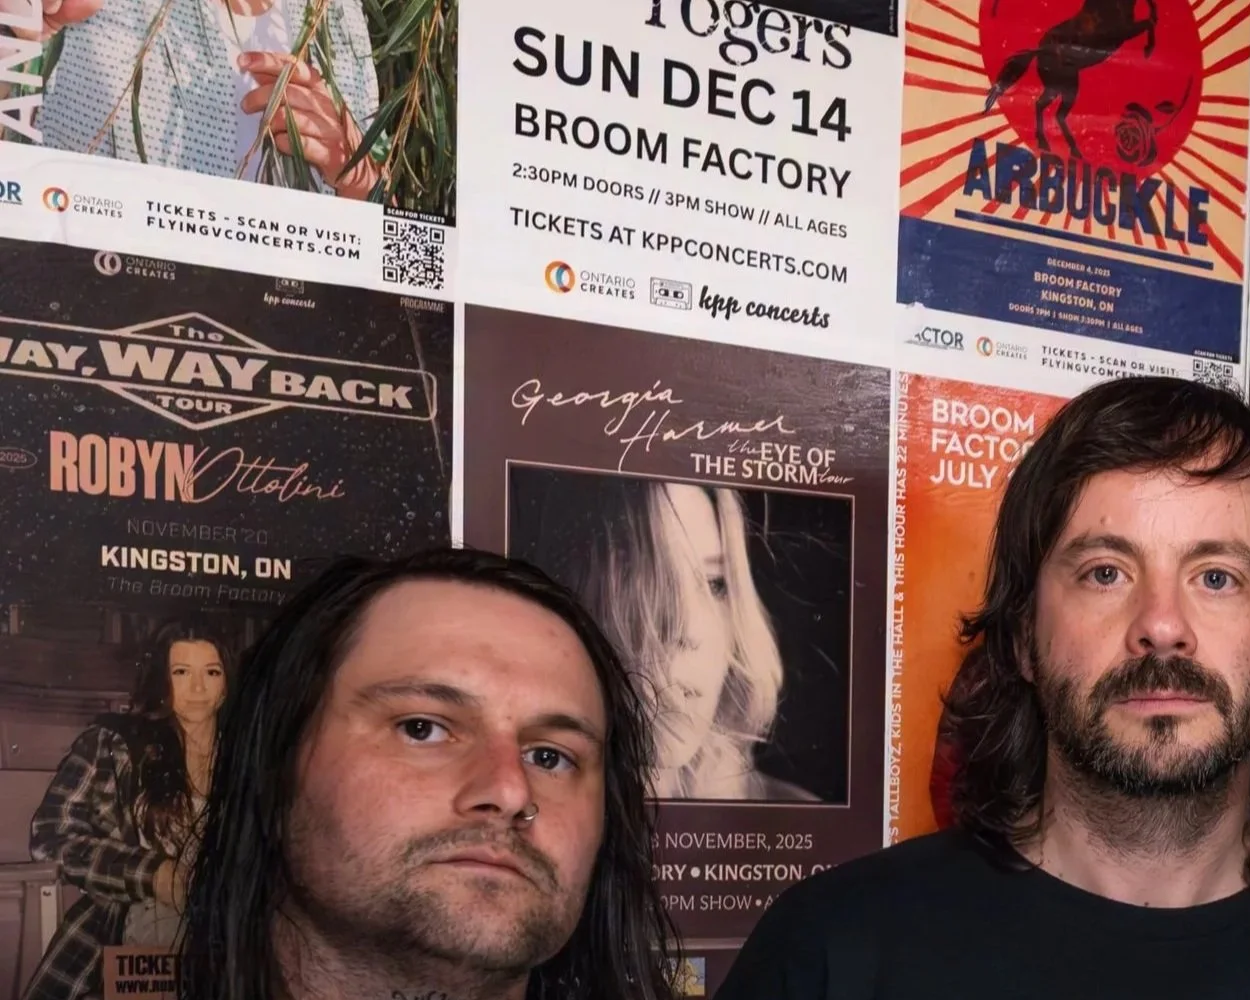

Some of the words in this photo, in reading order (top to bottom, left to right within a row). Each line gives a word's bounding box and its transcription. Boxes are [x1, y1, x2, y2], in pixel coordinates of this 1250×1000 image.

[512, 25, 641, 99] SUN
[662, 58, 776, 126] DEC
[791, 89, 852, 143] 14
[514, 102, 668, 165] BROOM
[682, 137, 852, 199] FACTORY
[73, 194, 123, 209] ONTARIO
[512, 162, 578, 190] 2:30PM
[583, 175, 645, 200] DOORS
[665, 191, 700, 211] 3PM
[704, 199, 755, 222] SHOW
[773, 212, 803, 231] ALL
[806, 218, 848, 239] AGES
[963, 138, 1210, 246] ARBUCKLE
[74, 204, 123, 218] CREATES
[146, 200, 216, 222] TICKETS
[237, 216, 280, 232] SCAN
[286, 225, 307, 236] OR
[316, 228, 361, 246] VISIT:
[386, 208, 404, 217] SCAN
[405, 211, 418, 219] FOR
[419, 213, 445, 224] TICKETS
[146, 216, 361, 260] FLYINGVCONCERTS.COM
[509, 207, 603, 241] TICKETS
[608, 226, 636, 247] AT
[641, 232, 848, 284] KPPCONCERTS.COM
[125, 255, 177, 273] ONTARIO
[125, 265, 177, 281] CREATES
[1047, 257, 1085, 272] DECEMBER
[580, 269, 636, 289] ONTARIO
[580, 283, 635, 300] CREATES
[1034, 271, 1074, 289] BROOM
[1076, 280, 1122, 298] FACTORY
[263, 292, 280, 306] kpp
[281, 296, 316, 309] concerts
[399, 297, 445, 313] PROGRAMME
[699, 285, 742, 320] kpp
[745, 299, 831, 330] concerts
[1009, 302, 1034, 314] DOORS
[1041, 289, 1097, 311] KINGSTON,
[1099, 301, 1114, 313] ON
[168, 323, 224, 343] The
[996, 350, 1028, 361] CREATES
[1042, 346, 1086, 361] TICKETS
[1100, 356, 1126, 368] SCAN
[1131, 361, 1145, 371] OR
[1149, 364, 1180, 377] VISIT:
[99, 339, 271, 394] WAY
[270, 369, 412, 410] BACK
[157, 394, 233, 415] TOUR
[511, 379, 683, 436] Georgia
[897, 373, 911, 441] MINUTES
[932, 398, 1035, 435] BROOM
[618, 410, 796, 472] Harmer
[761, 441, 802, 465] EYE
[806, 447, 837, 468] OF
[896, 445, 907, 464] 22
[50, 430, 195, 503] ROBYN
[183, 446, 346, 503] Ottolini
[690, 453, 737, 477] THE
[746, 459, 818, 485] STORM
[929, 459, 999, 489] JULY
[896, 467, 907, 500] HAS
[127, 518, 237, 541] NOVEMBER
[894, 504, 906, 548] HOUR
[101, 545, 248, 580] KINGSTON,
[254, 558, 292, 580] ON
[894, 553, 905, 585] THIS
[108, 576, 143, 594] The
[150, 579, 212, 600] Broom
[217, 582, 288, 605] Factory
[895, 588, 905, 602] &
[893, 605, 904, 640] HALL
[891, 648, 903, 676] THE
[891, 683, 903, 700] IN
[890, 702, 902, 738] KIDS
[665, 832, 771, 851] NOVEMBER,
[776, 833, 813, 850] 2025
[700, 894, 752, 911] SHOW
